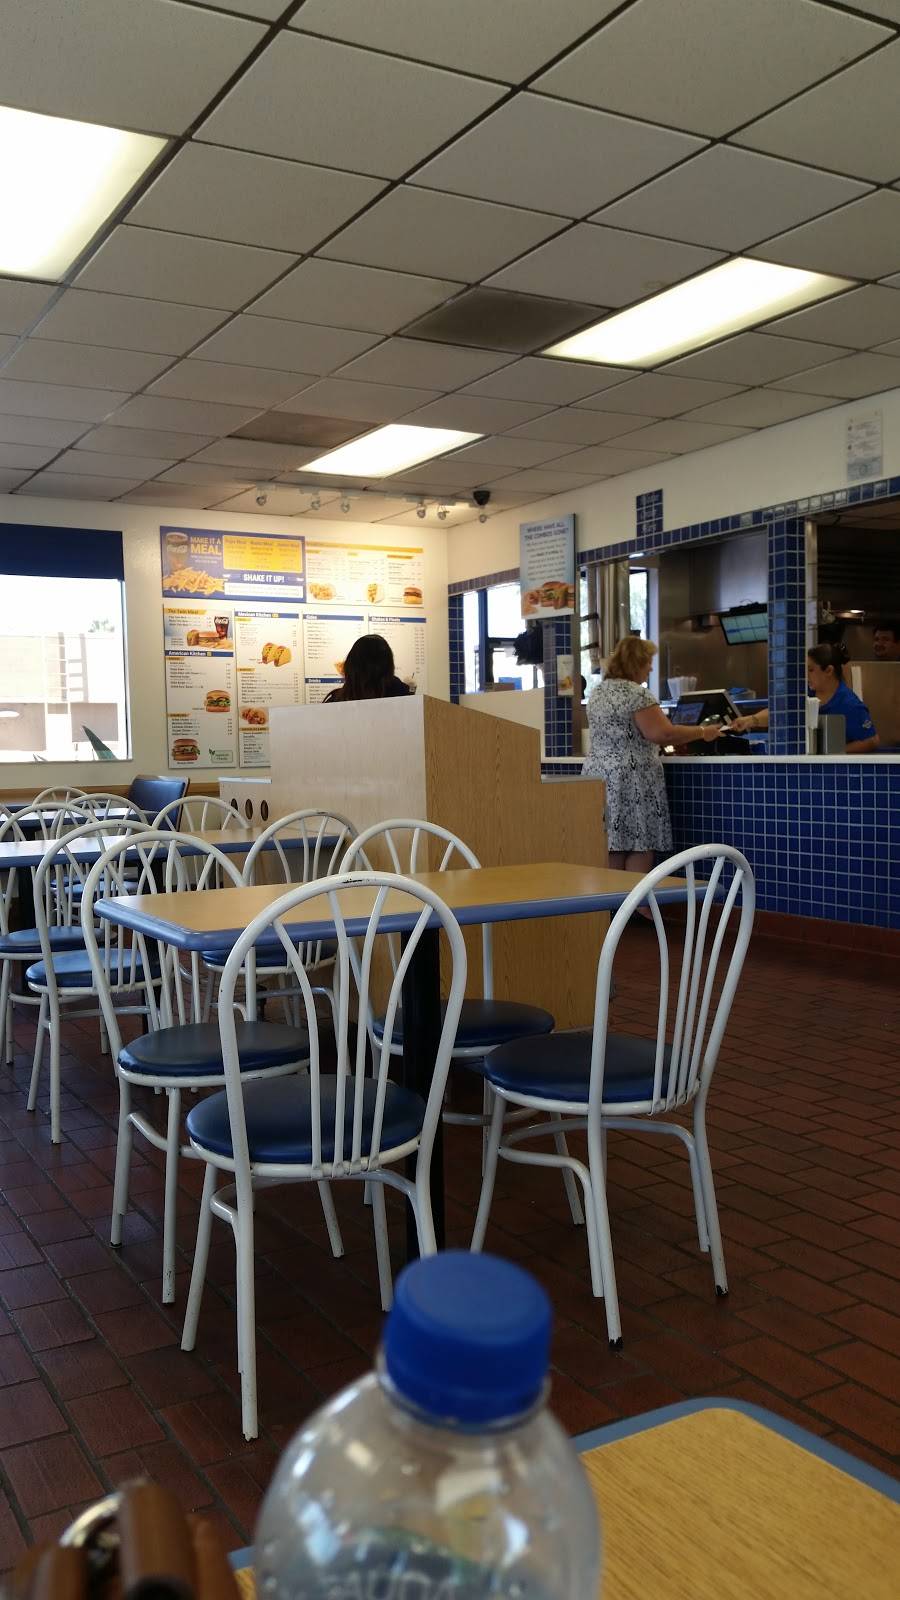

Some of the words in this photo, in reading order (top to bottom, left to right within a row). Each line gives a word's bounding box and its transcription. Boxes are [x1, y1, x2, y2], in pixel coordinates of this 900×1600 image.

[190, 536, 209, 544] MAKE
[190, 543, 222, 555] MEAL
[243, 573, 265, 582] SHAKE
[266, 574, 273, 582] IT
[273, 575, 285, 583] UP!
